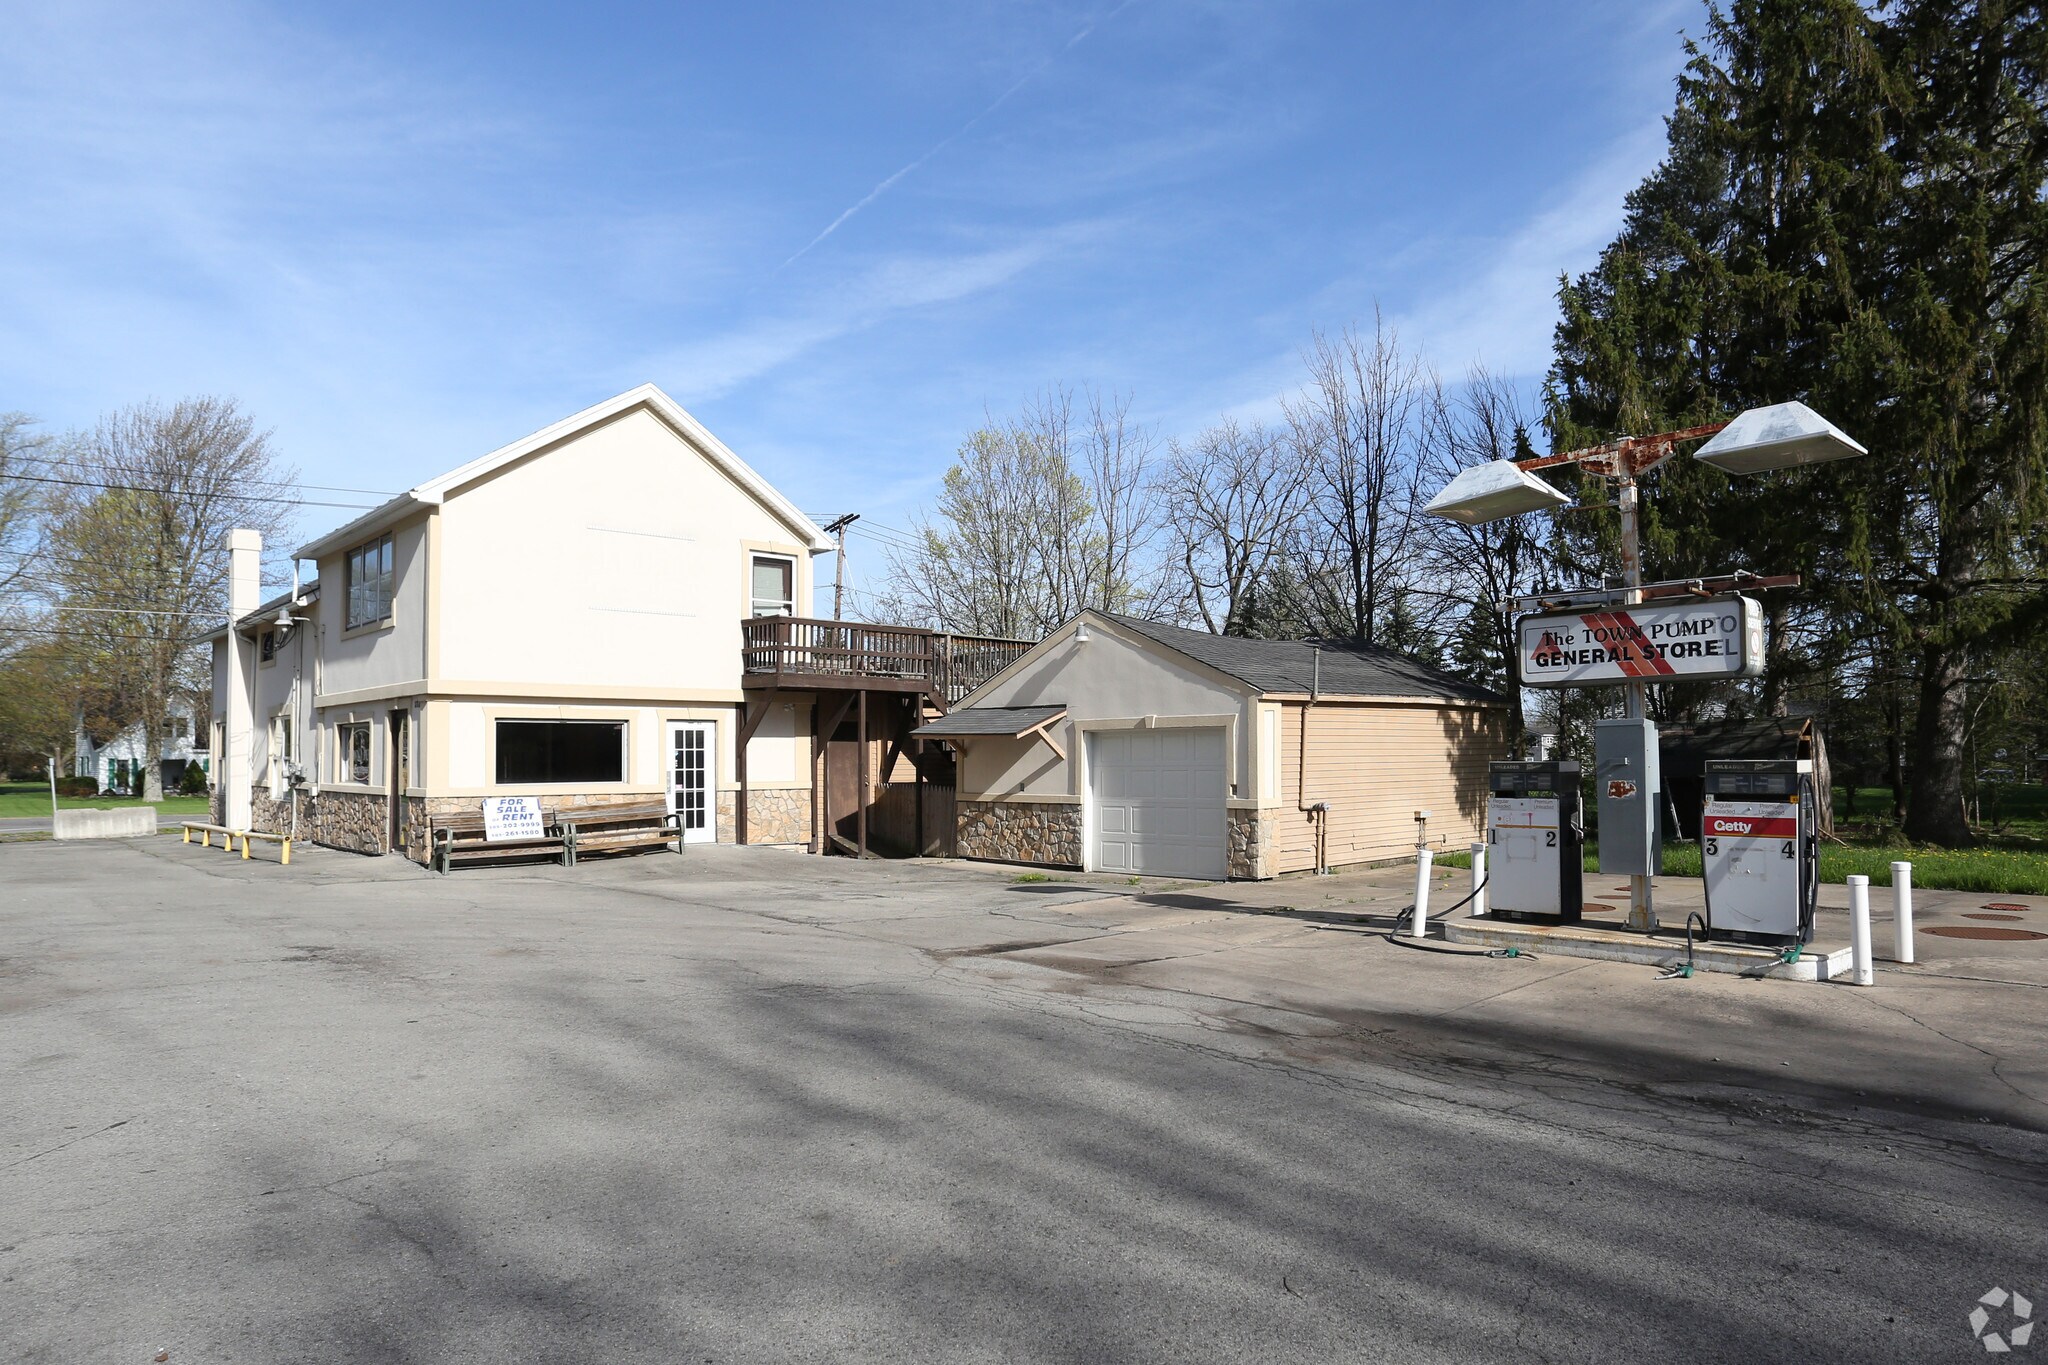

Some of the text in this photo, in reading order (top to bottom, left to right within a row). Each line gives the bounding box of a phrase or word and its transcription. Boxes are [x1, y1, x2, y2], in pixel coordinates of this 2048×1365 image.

[1542, 619, 1715, 646] The TOWN PUMP
[1535, 645, 1634, 667] GENERAL
[1642, 639, 1720, 660] STORE
[500, 798, 524, 806] FOR
[497, 806, 527, 814] SALE
[502, 813, 535, 821] RENT
[1713, 819, 1752, 834] Getty
[1491, 829, 1497, 844] 1
[1546, 831, 1557, 847] 2
[1706, 838, 1718, 855] 3
[1781, 841, 1795, 859] 4
